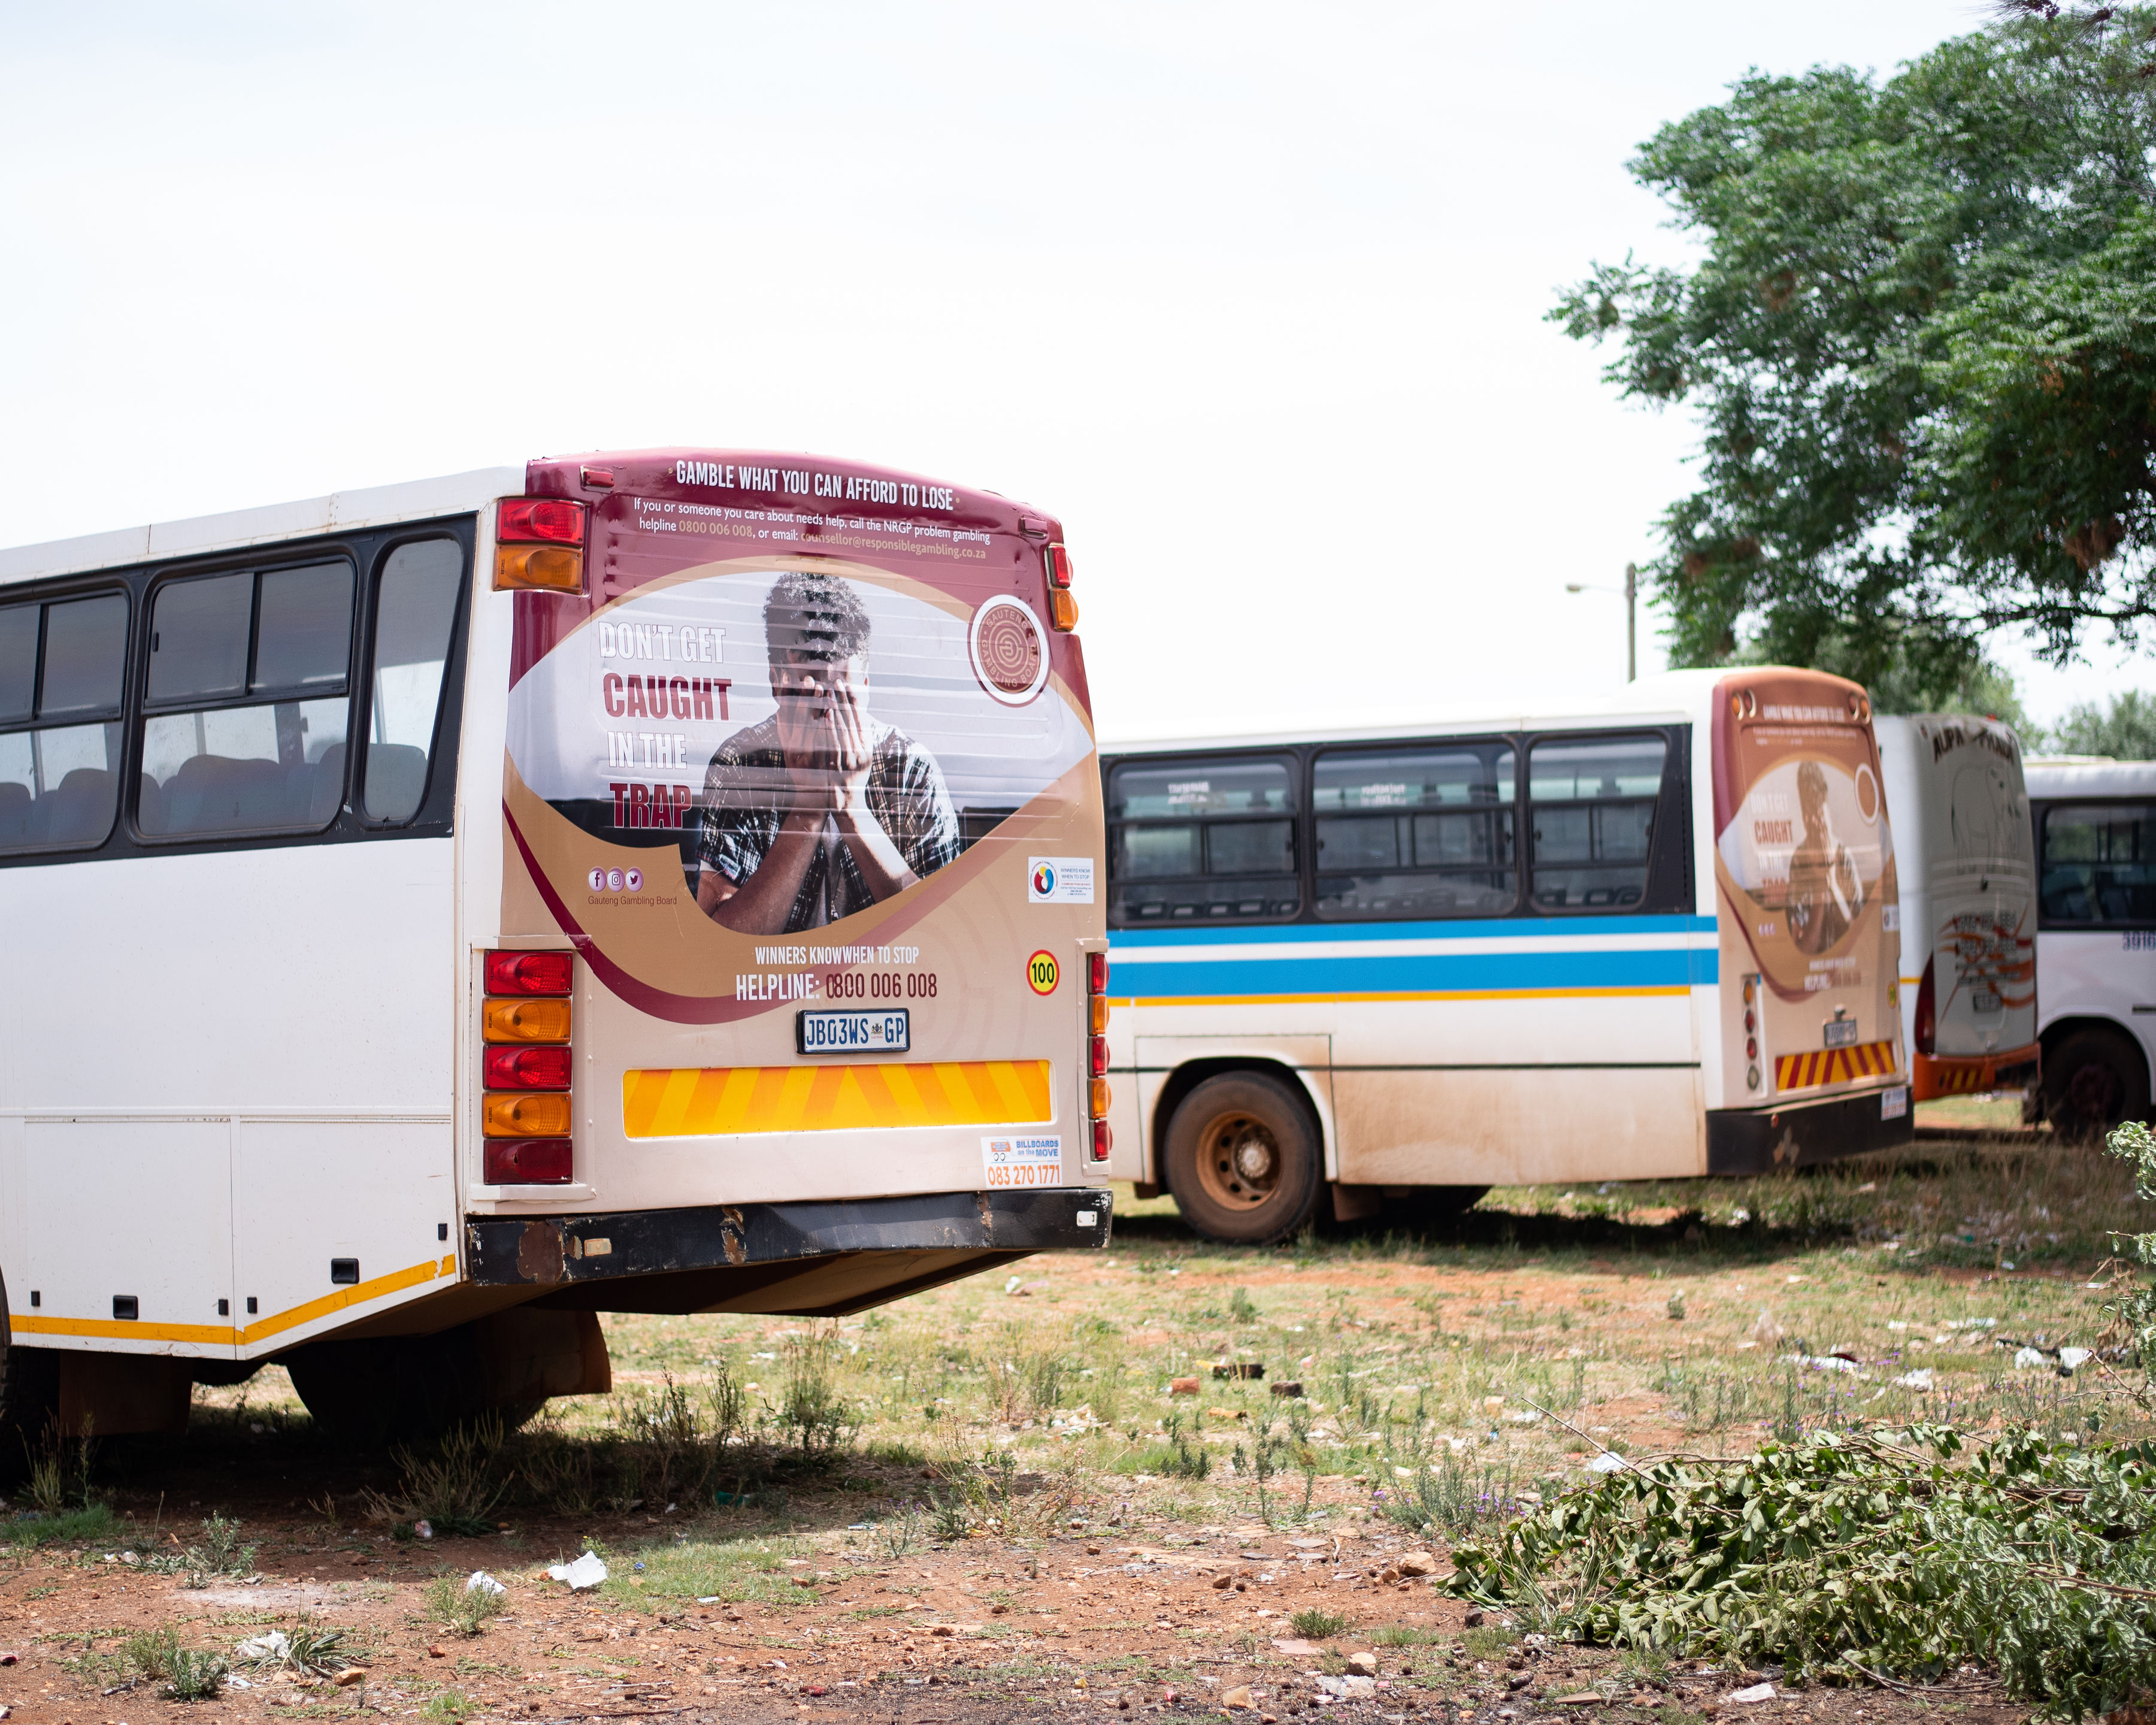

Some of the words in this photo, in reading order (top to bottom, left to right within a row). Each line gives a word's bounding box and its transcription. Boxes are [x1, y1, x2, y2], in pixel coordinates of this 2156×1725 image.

[676, 460, 734, 488] GAMBLE
[738, 466, 778, 492] WHAT
[782, 470, 808, 495] YOU
[814, 473, 841, 498] CAN
[846, 477, 897, 504] AFFORD
[901, 483, 918, 507] TO
[922, 486, 953, 510] LOSE
[634, 498, 640, 510] If
[643, 501, 661, 514] you
[664, 503, 675, 512] or
[679, 504, 722, 516] someone
[725, 509, 741, 520] you
[744, 510, 764, 520] care
[767, 510, 794, 523] about
[797, 514, 823, 525] needs
[826, 515, 847, 529] help,
[850, 518, 864, 529] call
[867, 519, 880, 531] the
[884, 521, 912, 534] NRGP
[915, 525, 950, 538] problem
[953, 529, 991, 545] gambling
[639, 517, 676, 534] helpline
[679, 520, 707, 533] 0800
[709, 523, 730, 535] 006
[732, 524, 755, 539] 008,
[758, 528, 769, 538] or
[772, 529, 798, 541] email:
[801, 532, 986, 559] counsellor@responsiblegambling.co.za
[986, 609, 1028, 630] GAUTENG
[598, 621, 673, 661] DON'T
[679, 626, 726, 664] GET
[982, 639, 1018, 687] GAMBLING
[1021, 644, 1037, 683] BOARD
[603, 672, 732, 721] CAUGHT
[607, 731, 634, 768] IN
[638, 733, 688, 770] THE
[609, 782, 692, 828] TRAP
[1754, 819, 1793, 845] CAUGHT
[588, 895, 618, 906] Gauteng
[620, 895, 654, 906] Gambling
[656, 896, 677, 905] Board
[755, 946, 806, 965] WINNERS
[877, 946, 891, 964] TO
[893, 946, 919, 964] STOP
[1032, 962, 1054, 983] 100
[736, 973, 820, 1001] HELPLINE:
[826, 973, 865, 998] 0800
[871, 973, 901, 998] 006
[907, 973, 937, 998] 008
[885, 1017, 904, 1043] GP
[1016, 1140, 1059, 1148] BILLBOARDS
[988, 1166, 1010, 1185] 083
[1013, 1165, 1034, 1185] 270
[1037, 1164, 1059, 1184] 1771
